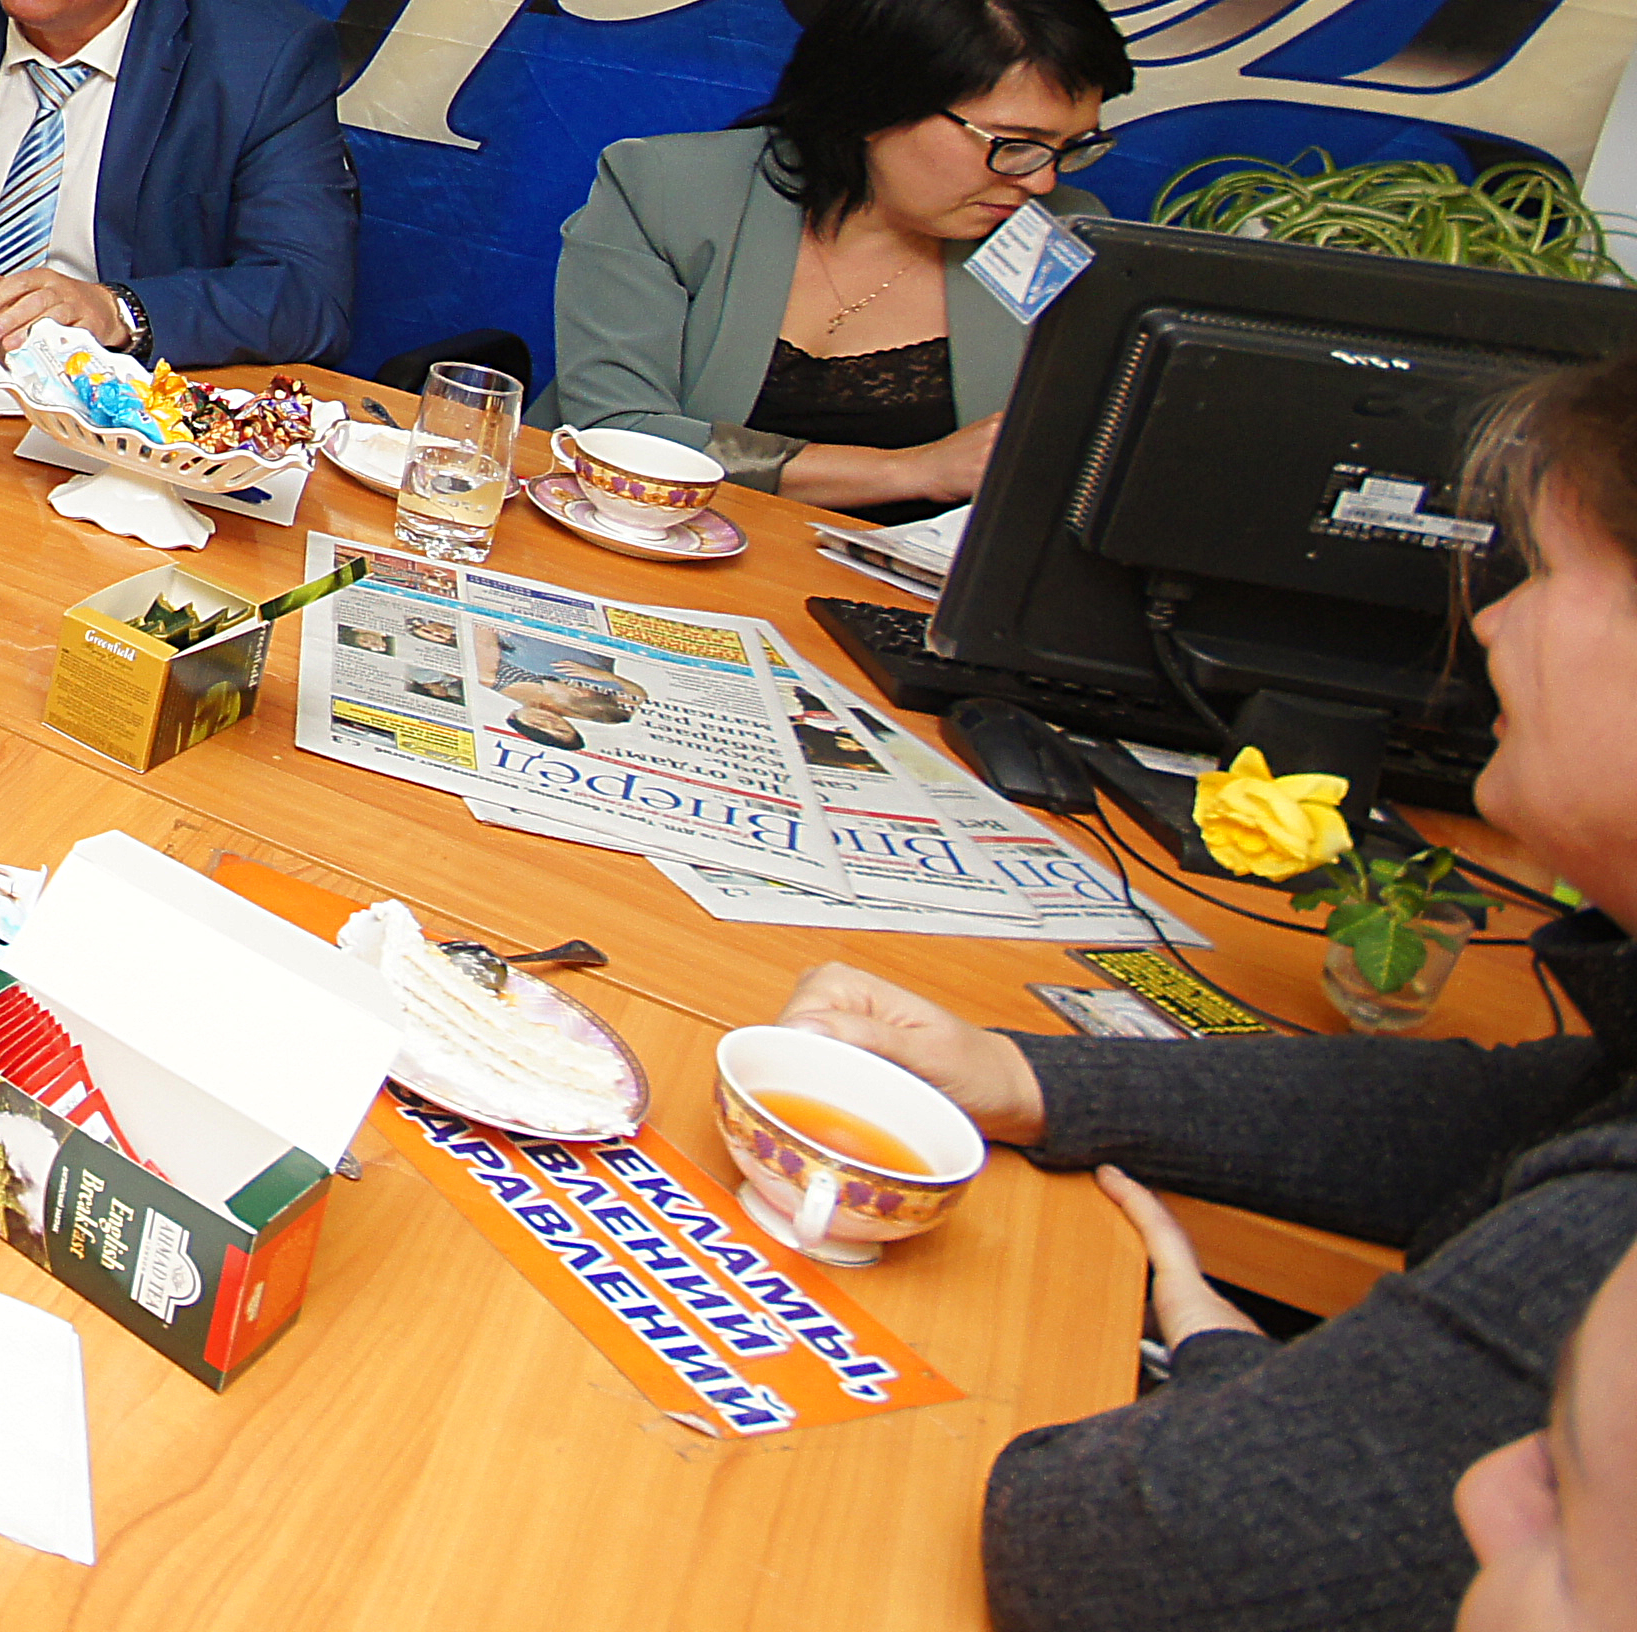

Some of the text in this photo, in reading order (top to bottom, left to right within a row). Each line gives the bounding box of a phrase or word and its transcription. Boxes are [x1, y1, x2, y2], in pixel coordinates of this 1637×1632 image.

[84, 629, 137, 662] Greenfield
[639, 720, 783, 758] забирает
[649, 733, 787, 769] кукушка
[699, 721, 778, 744] сына
[491, 739, 808, 855] Вперёд
[599, 747, 798, 800] "Не отдам!"
[702, 756, 791, 783] Дочь-
[69, 1167, 106, 1260] Breakfast
[99, 1197, 135, 1272] English
[502, 1130, 791, 1355] ВЛЕНИЙ
[145, 1222, 175, 1310] AHMAD TEA
[595, 1134, 897, 1401] ЕКЛАМЫ,
